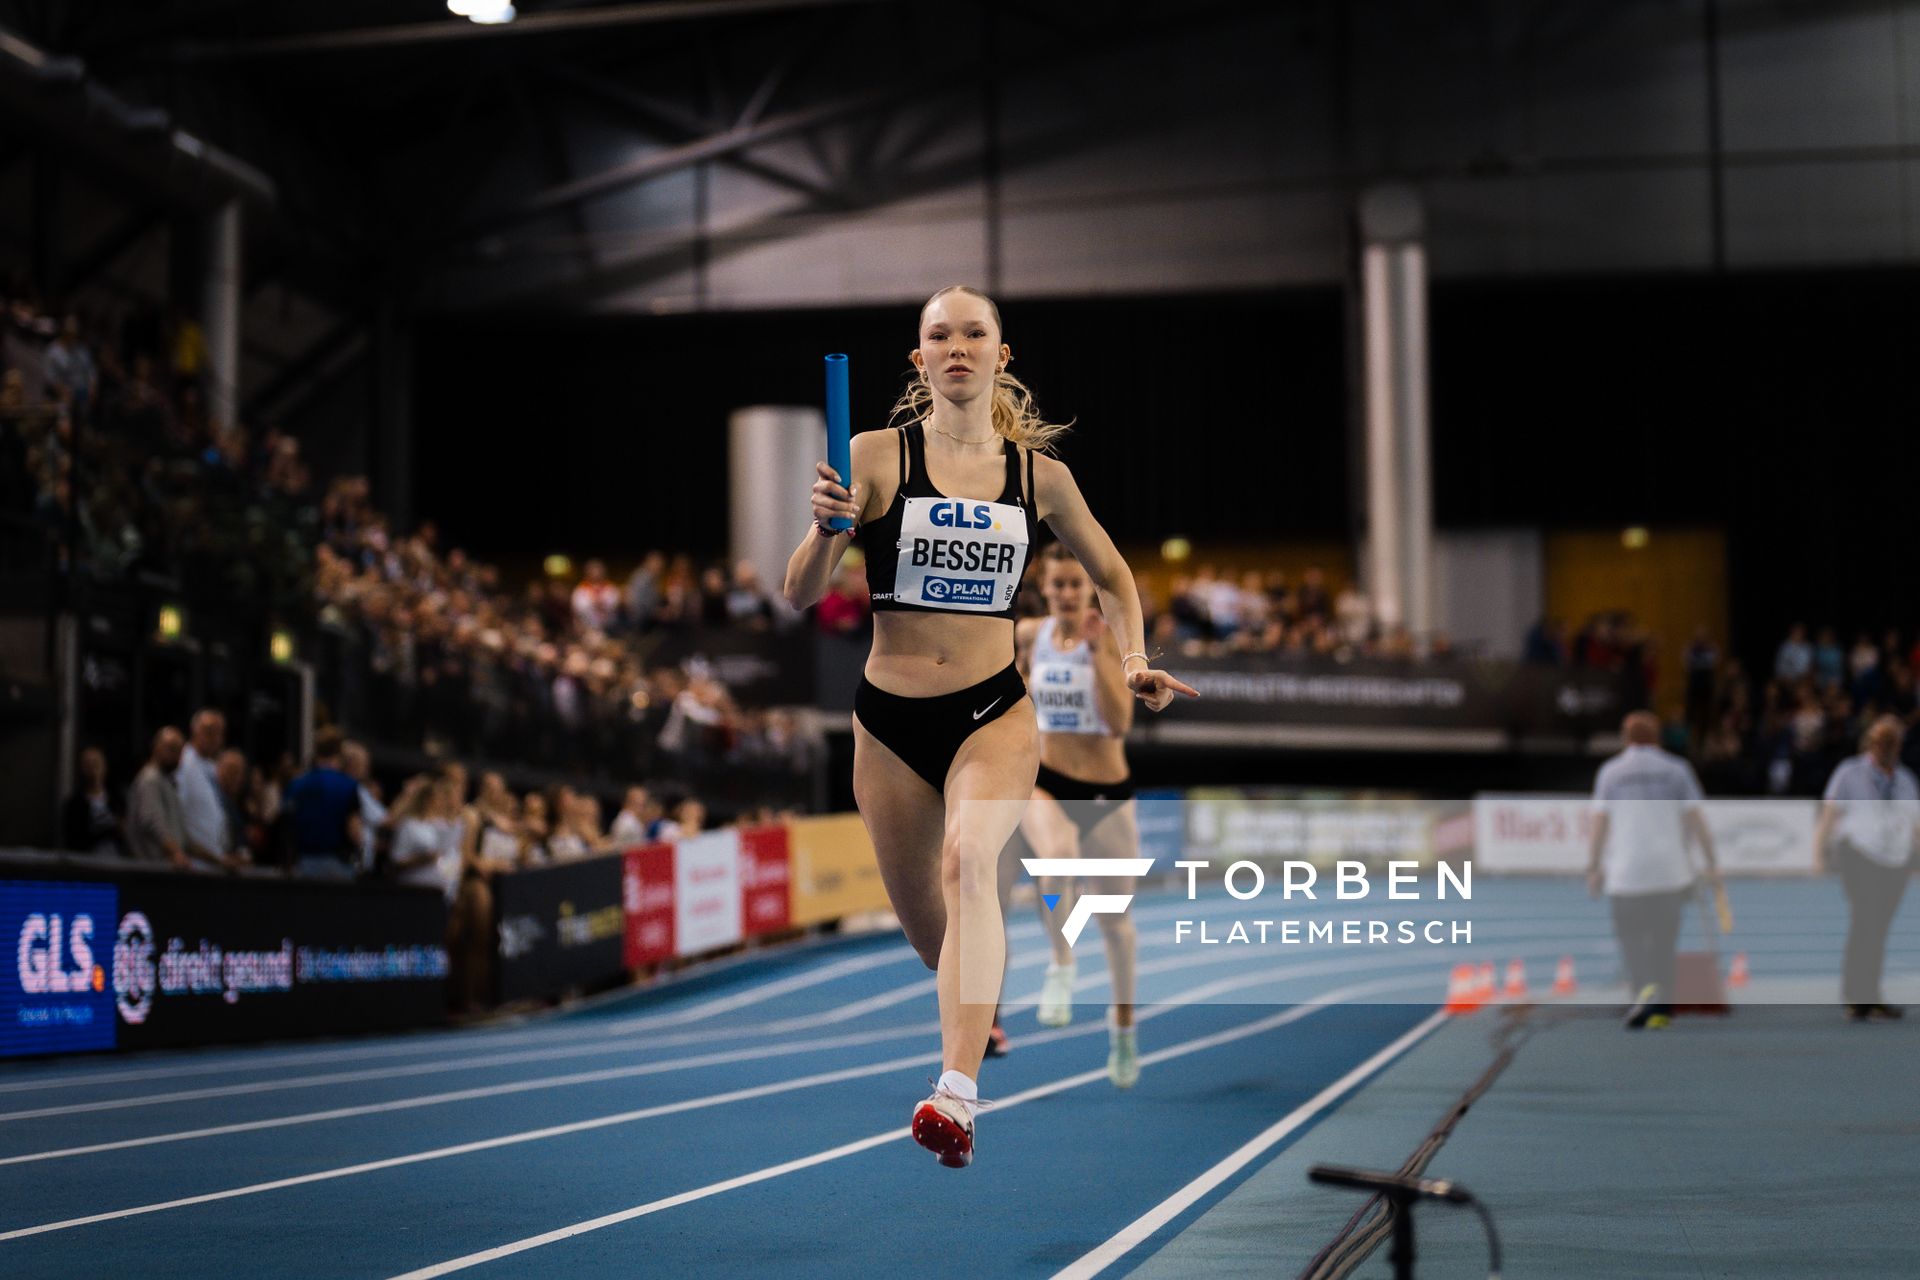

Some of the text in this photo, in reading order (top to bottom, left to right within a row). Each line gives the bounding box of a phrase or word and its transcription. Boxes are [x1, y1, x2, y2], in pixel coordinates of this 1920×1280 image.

[912, 538, 1015, 574] BESSER
[872, 592, 893, 600] CRAFT
[952, 583, 991, 596] PLAN
[1004, 584, 1014, 601] 409
